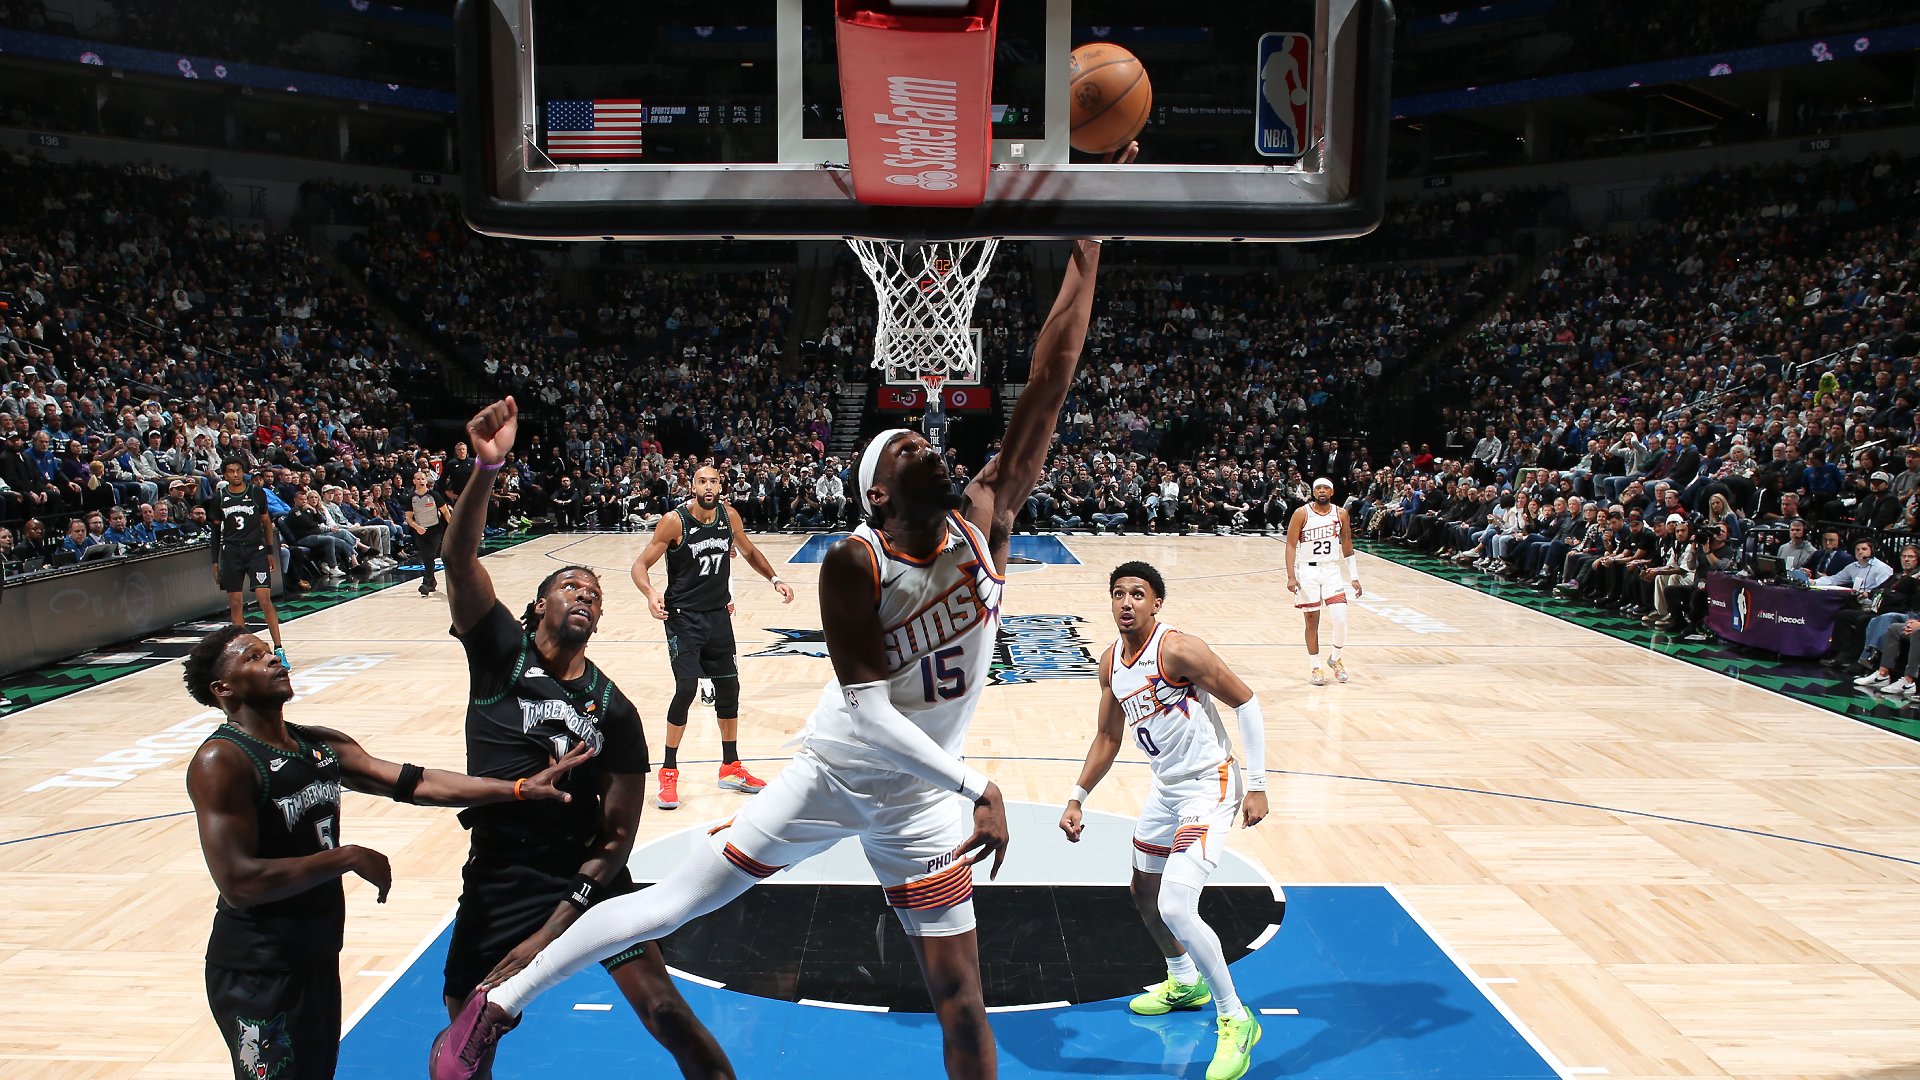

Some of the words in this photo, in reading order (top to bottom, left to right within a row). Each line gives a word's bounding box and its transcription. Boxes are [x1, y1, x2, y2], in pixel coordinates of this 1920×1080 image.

[40, 135, 59, 146] 136
[1263, 129, 1288, 148] NBA
[419, 174, 434, 184] 138
[929, 427, 940, 437] GET
[930, 436, 940, 445] THE
[234, 515, 245, 530] 3
[1303, 523, 1335, 542] SUNS
[687, 537, 730, 560] TIMBERWOLVES
[1313, 540, 1331, 555] 23
[698, 553, 725, 577] 27
[1762, 612, 1776, 620] NBC
[1778, 614, 1805, 625] pacock
[920, 645, 968, 703] 15
[1137, 727, 1160, 756] 0
[314, 815, 335, 850] 5
[580, 882, 592, 897] 11
